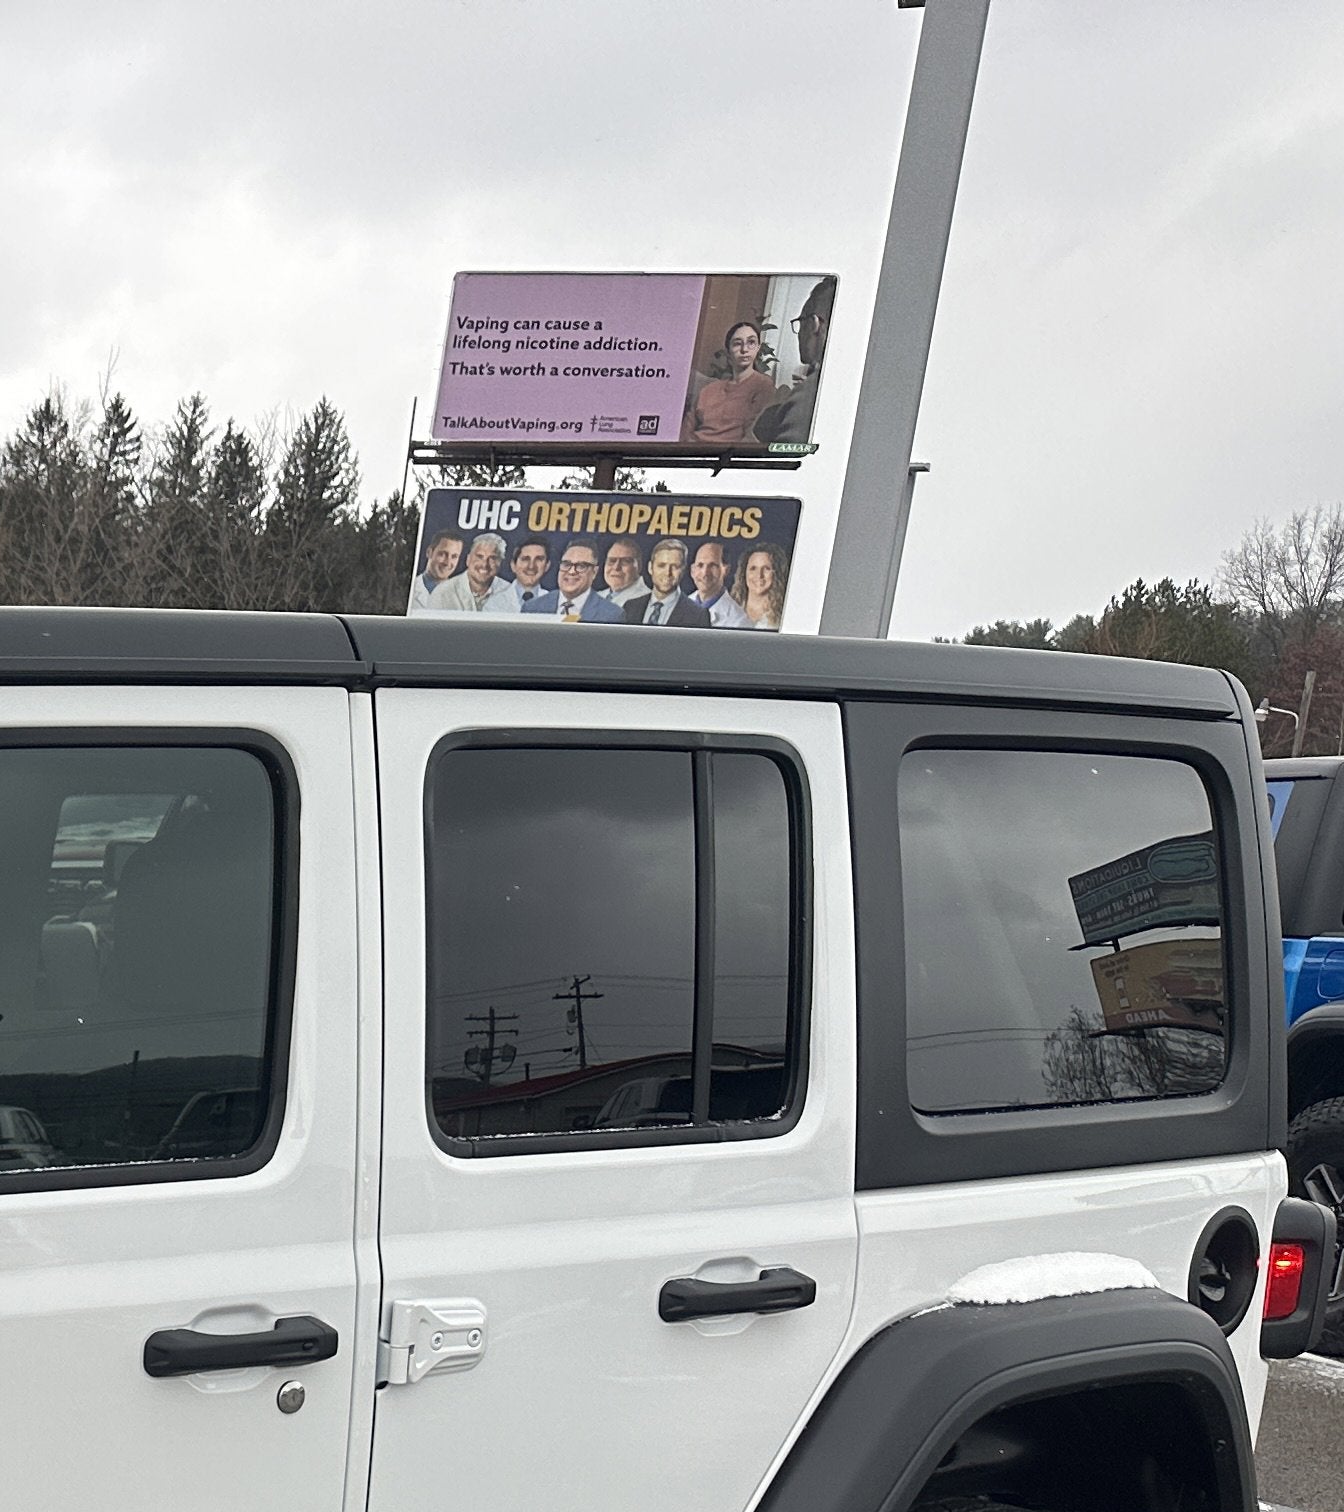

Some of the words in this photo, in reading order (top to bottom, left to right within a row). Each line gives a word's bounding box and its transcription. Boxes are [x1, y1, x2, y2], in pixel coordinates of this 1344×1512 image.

[457, 316, 509, 333] Vaping
[513, 319, 540, 331] can
[545, 319, 590, 331] cause
[594, 320, 603, 331] a
[452, 335, 511, 353] lifelong
[515, 336, 580, 350] nicotine
[583, 337, 663, 352] addiction.
[449, 362, 495, 376] That's
[500, 363, 546, 377] worth
[550, 366, 559, 377] a
[563, 364, 671, 378] conversation.
[442, 416, 583, 433] TalkAboutVaping.org
[458, 499, 520, 531] UHC
[528, 500, 761, 538] ORTHOPAEDICS
